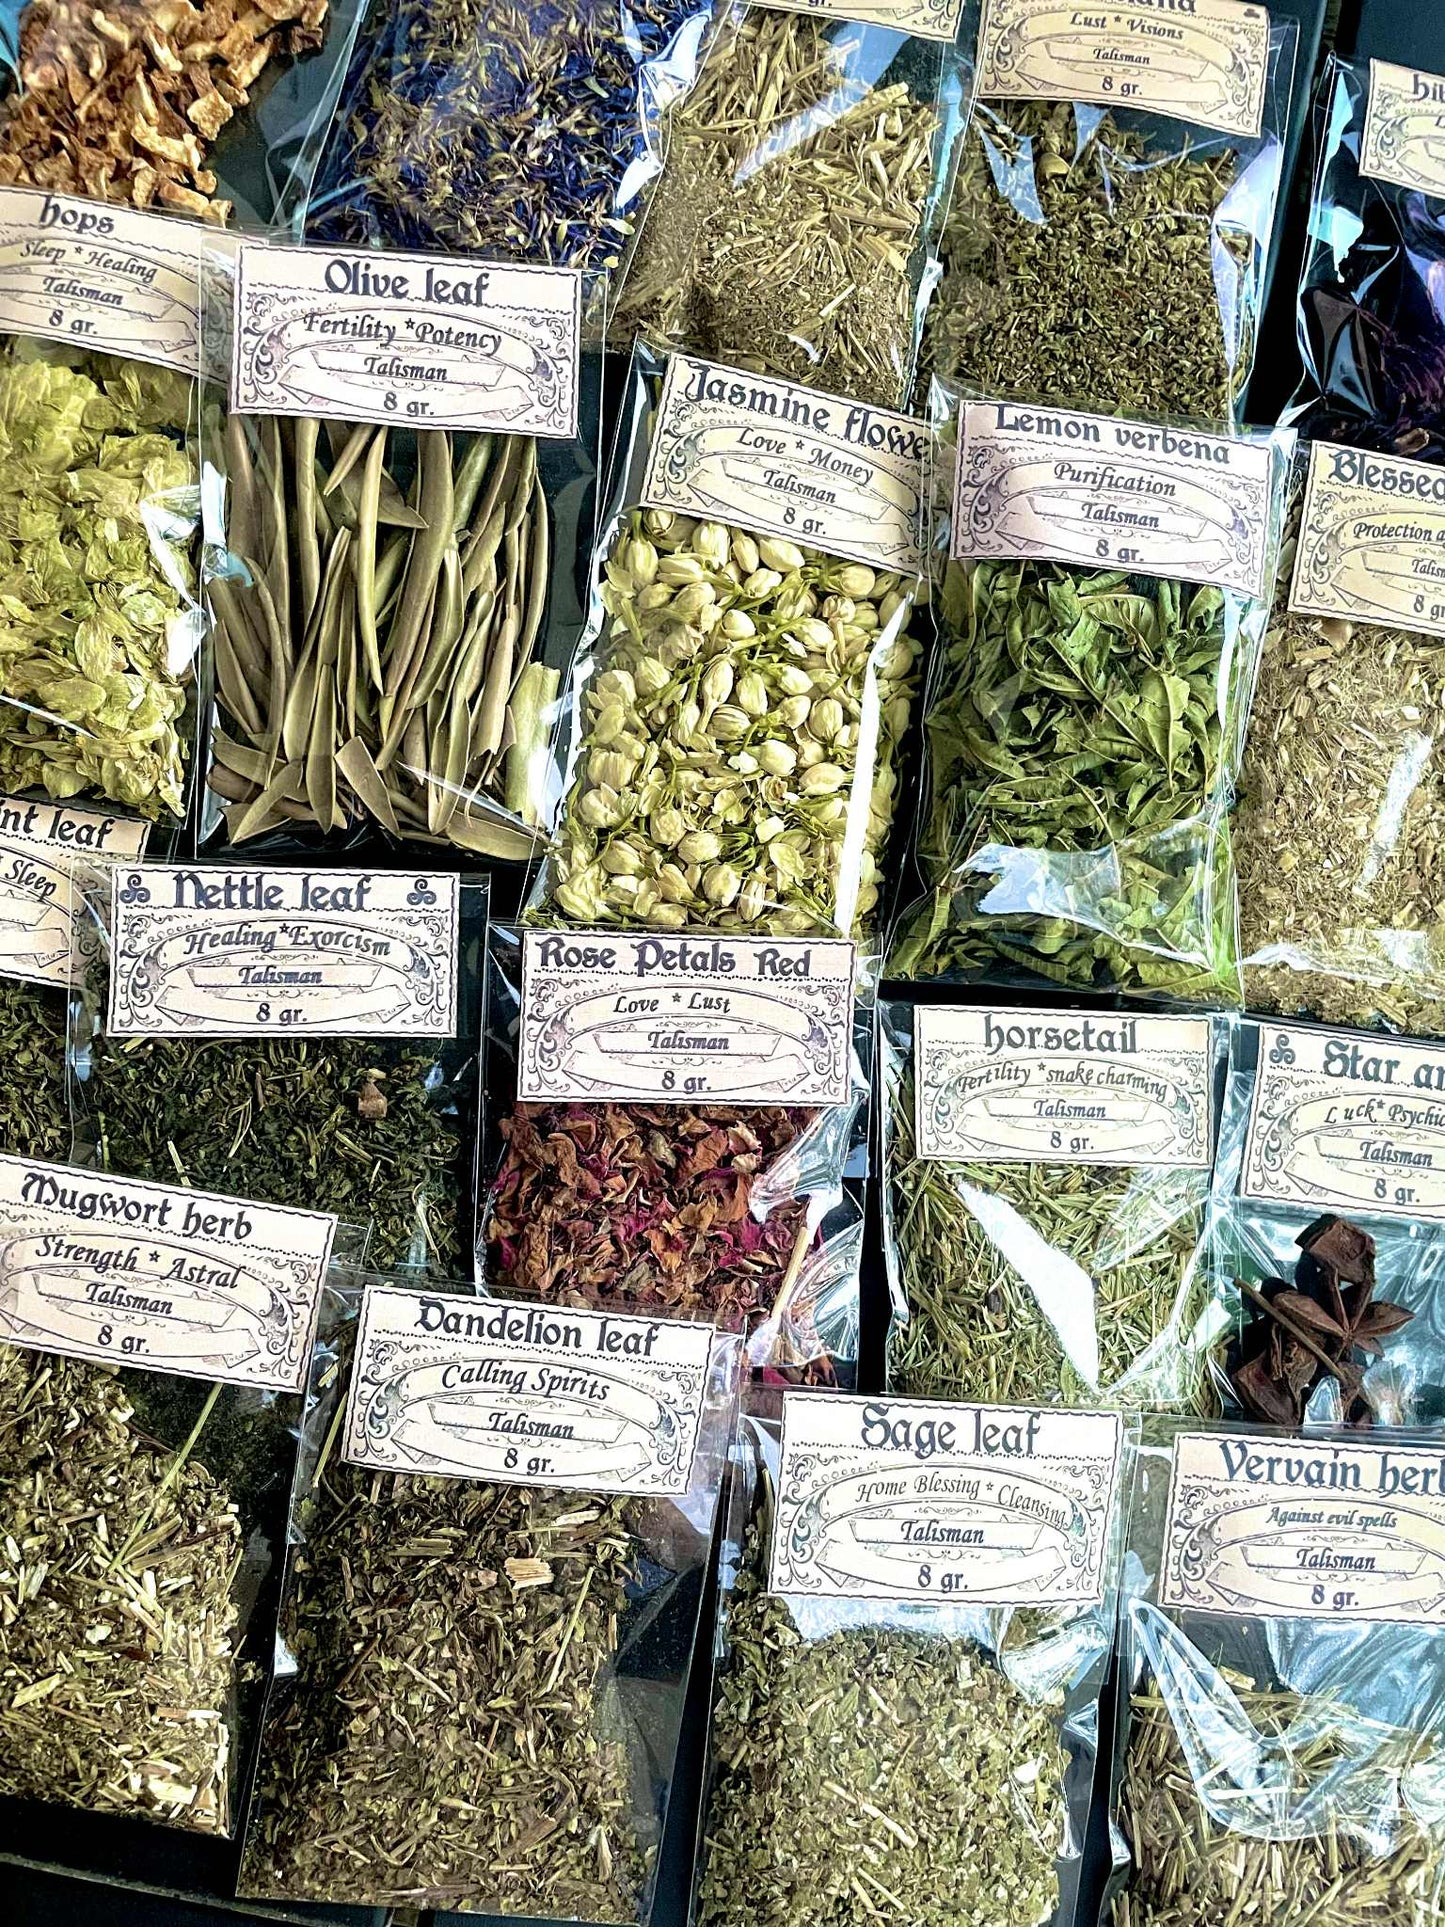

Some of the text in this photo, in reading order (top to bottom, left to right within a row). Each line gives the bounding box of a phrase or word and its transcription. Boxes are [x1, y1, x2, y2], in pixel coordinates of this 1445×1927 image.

[1070, 12, 1183, 40] Lust Visions
[1093, 48, 1150, 65] Talisman
[1102, 76, 1143, 96] 8 gr.
[20, 239, 157, 284] Sleep Healing
[43, 277, 123, 306] Talisman
[325, 260, 489, 305] Olive leaf
[49, 310, 98, 334] 8 gr.
[304, 313, 501, 356] Fertility Potency
[364, 356, 447, 381] Talisman
[384, 392, 434, 417] 8 gr.
[685, 360, 830, 430] Jasmine
[995, 404, 1230, 465] Lemon verbena
[736, 428, 874, 484] Love Money
[763, 469, 836, 504] Talisman
[1053, 462, 1176, 497] Purification
[783, 506, 827, 535] 8 gr.
[1081, 502, 1160, 528] Talisman
[1353, 521, 1432, 542] Protection
[1095, 539, 1144, 565] 8 gr.
[1414, 594, 1424, 613] 8
[0, 799, 116, 848] nt leaf
[5, 859, 57, 901] Sleep
[172, 873, 372, 910] Nettle leaf
[184, 923, 391, 956] Healing Exorcism
[535, 937, 812, 977] Rose Petals Red
[238, 965, 322, 985] Talisman
[256, 1003, 307, 1026] 8 gr.
[613, 992, 731, 1014] Love Lust
[648, 1030, 730, 1050] Talisman
[1323, 1040, 1401, 1084] Star
[661, 1070, 712, 1094] 8 gr.
[1046, 1061, 1093, 1087] snake
[1097, 1066, 1167, 1102] charming
[1033, 1099, 1106, 1118] Talisman
[1324, 1098, 1377, 1124] Luck
[1050, 1131, 1094, 1153] 8 gr.
[1360, 1141, 1432, 1167] Talisman
[21, 1172, 251, 1239] Mugwort herb
[1374, 1178, 1420, 1205] 8 gr.
[35, 1234, 246, 1289] Strength Astral
[85, 1283, 173, 1315] Talisman
[98, 1325, 150, 1354] 8 gr.
[414, 1298, 663, 1357] Dandelion leaf
[441, 1360, 610, 1401] Calling Spirits
[488, 1412, 574, 1438] Talisman
[861, 1403, 1041, 1459] Sage leaf
[504, 1448, 555, 1475] 8 gr.
[1219, 1440, 1361, 1489] Vervain
[855, 1471, 1066, 1531] Home Blessing Cleansing
[900, 1520, 985, 1544] Talisman
[1266, 1507, 1398, 1532] Against evil spells
[1297, 1549, 1376, 1570] Talisman
[918, 1564, 968, 1593] 8 gr.
[1312, 1585, 1360, 1611] 8 gr.
